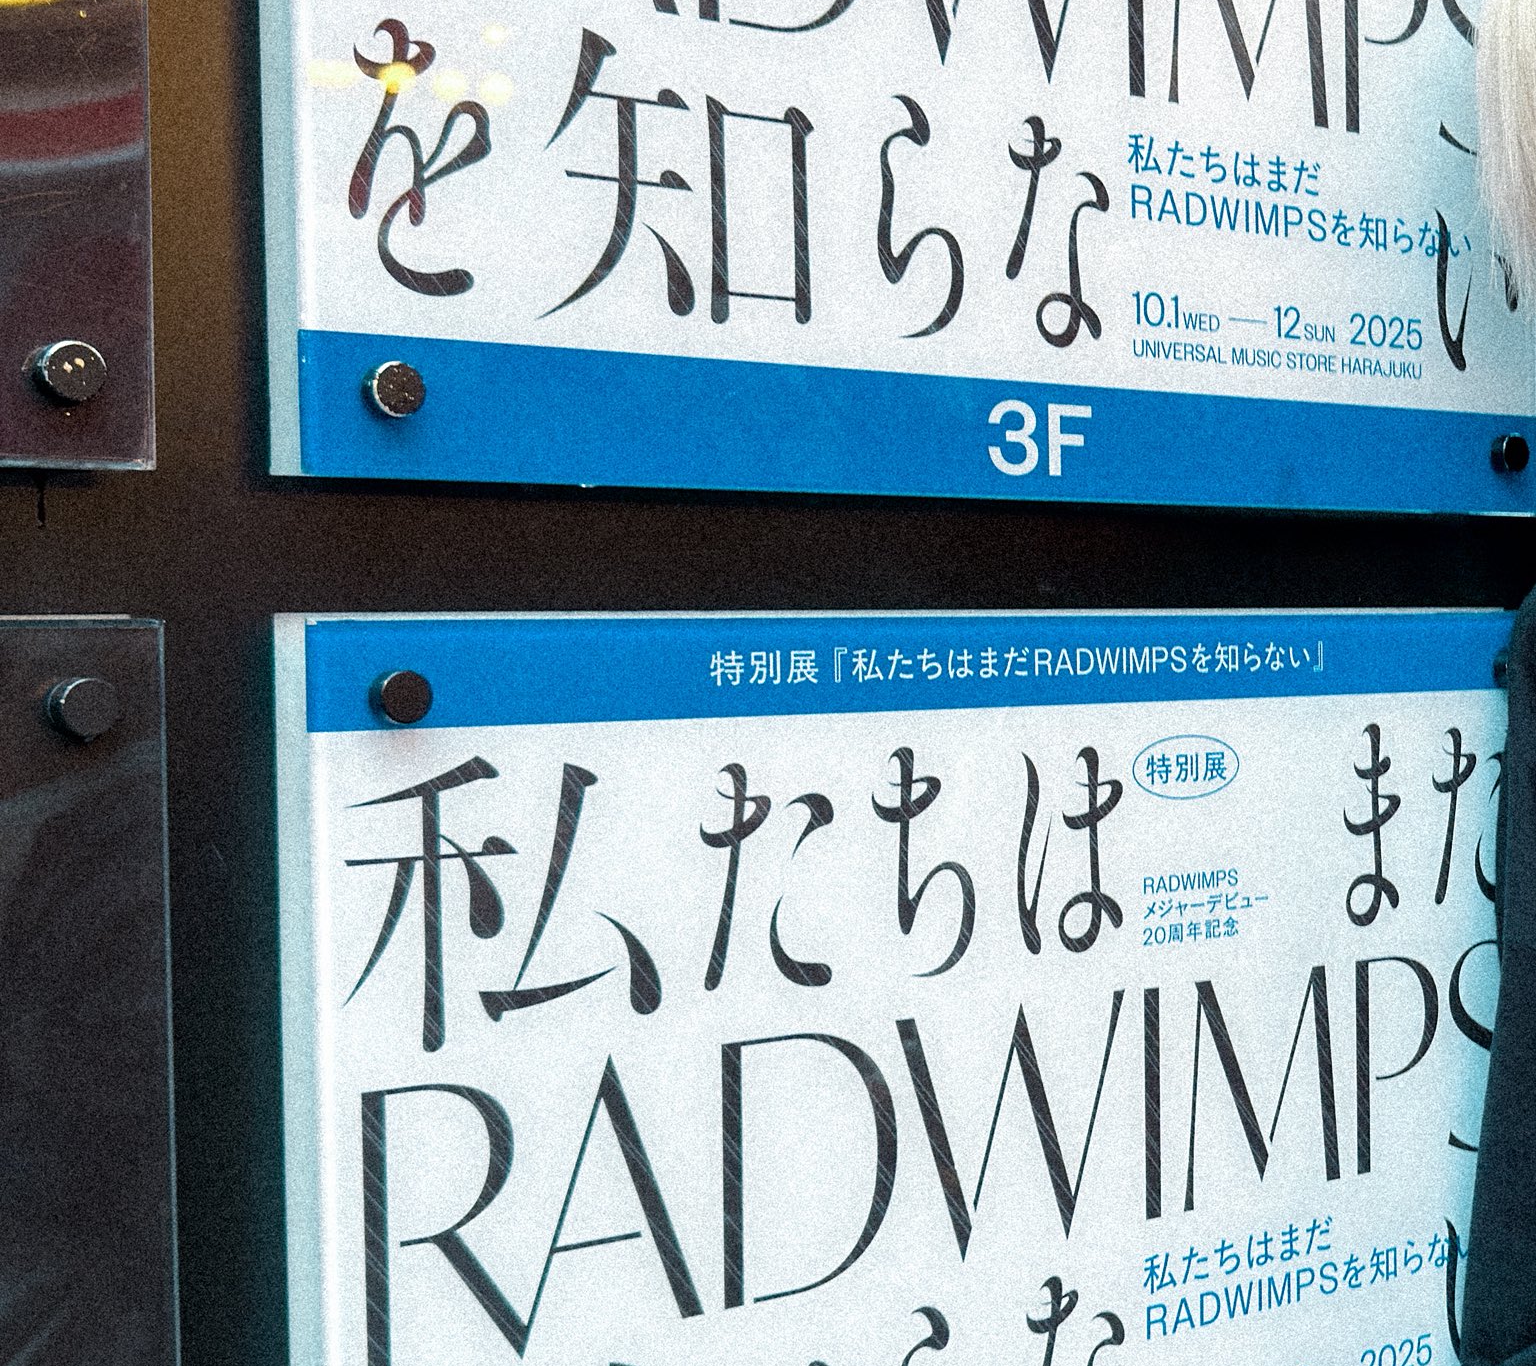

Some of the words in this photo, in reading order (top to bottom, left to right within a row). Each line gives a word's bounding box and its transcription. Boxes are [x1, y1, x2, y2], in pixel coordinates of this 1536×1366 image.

[1127, 133, 1321, 197] 私たちはまだ
[1131, 184, 1472, 258] RADWIMPSを知らない
[1349, 313, 1424, 351] 2025
[1132, 339, 1228, 366] UNIVERSAL
[1231, 348, 1282, 370] MUSIC
[1286, 353, 1338, 375] STORE
[1341, 357, 1423, 381] HARAJUKU
[987, 398, 1093, 478] 3F
[1146, 751, 1228, 785] 特別展
[341, 745, 1124, 1054] 私たちは
[1143, 868, 1239, 895] RADWIMPS
[1143, 891, 1270, 921] メジャーデビュー
[1143, 915, 1240, 947] 20周年記念
[1143, 1216, 1333, 1295] 私たちはまだ
